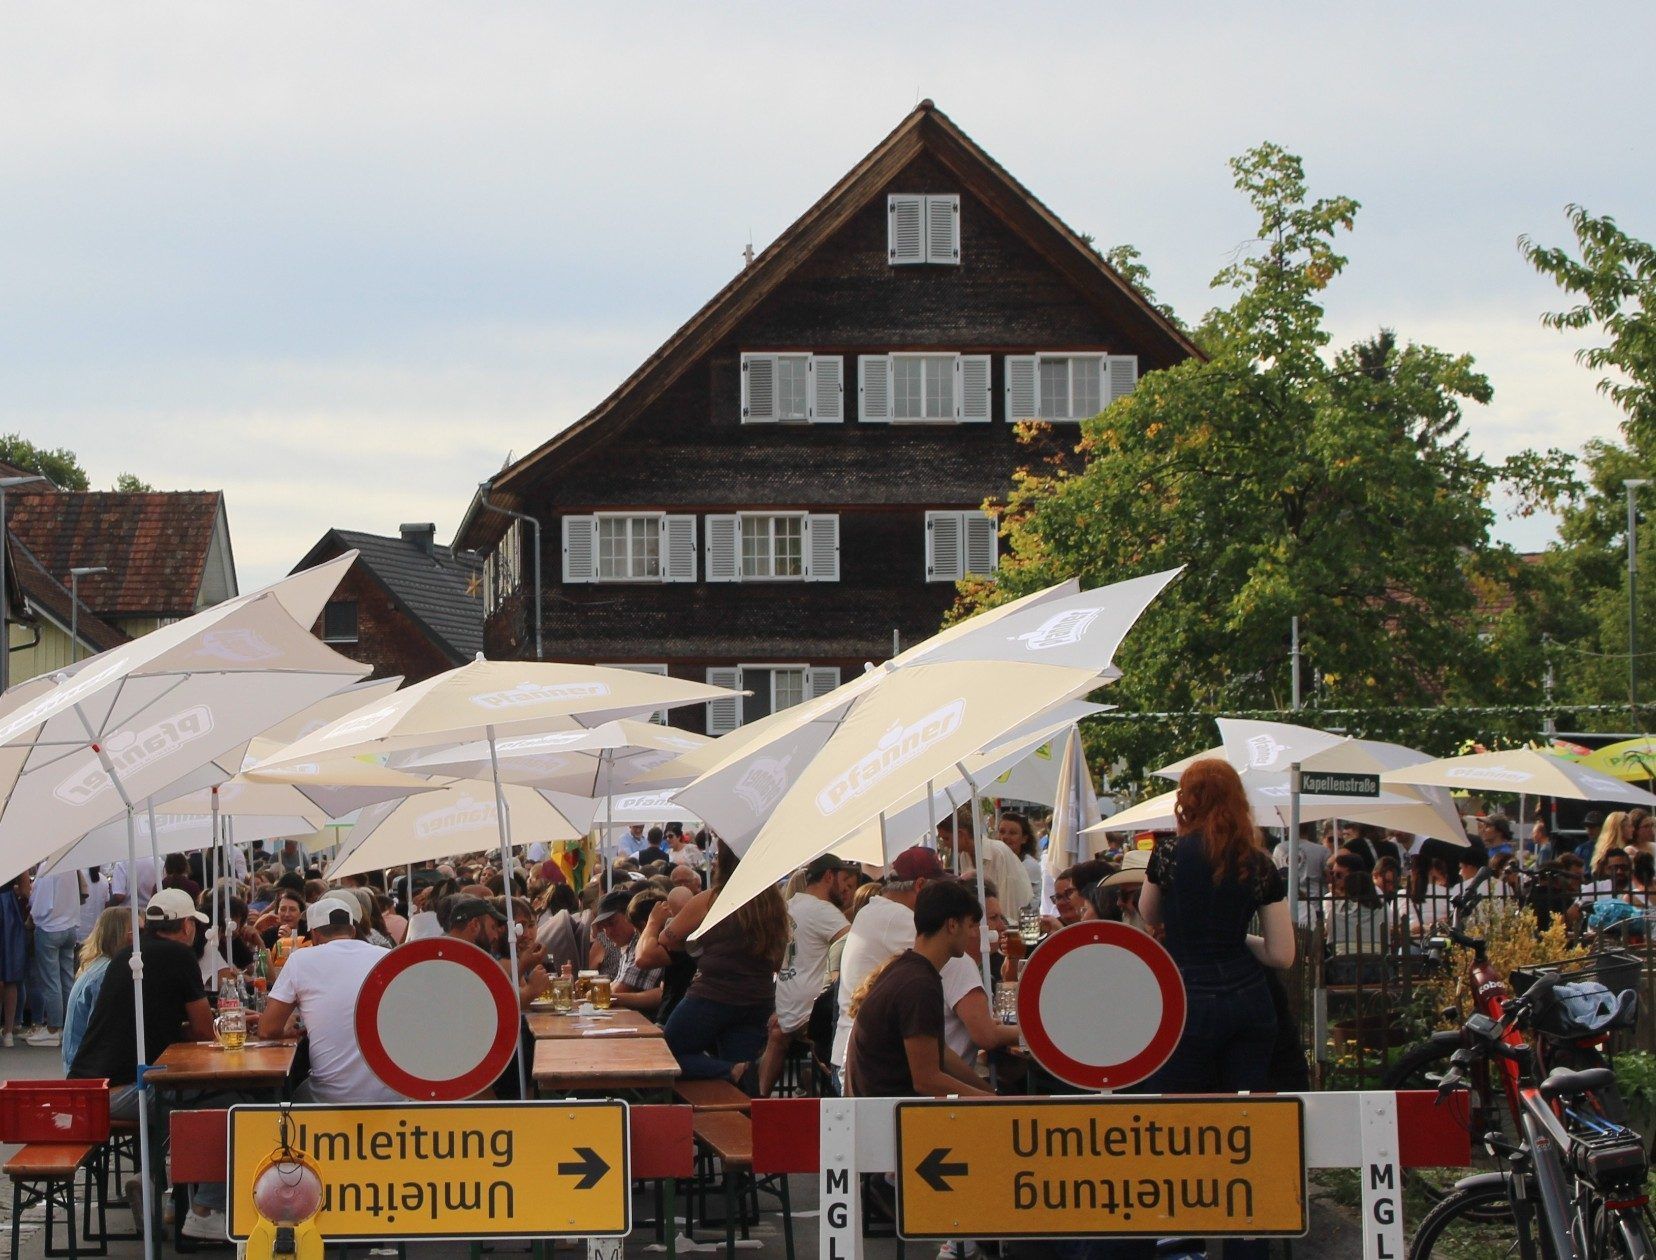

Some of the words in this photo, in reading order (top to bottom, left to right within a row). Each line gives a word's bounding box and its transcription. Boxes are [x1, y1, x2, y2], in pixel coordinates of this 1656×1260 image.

[1303, 775, 1377, 793] Kapellenstraße
[1012, 1115, 1252, 1165] Umleitung
[1014, 1171, 1253, 1220] Umleitung
[1370, 1163, 1394, 1259] MGL
